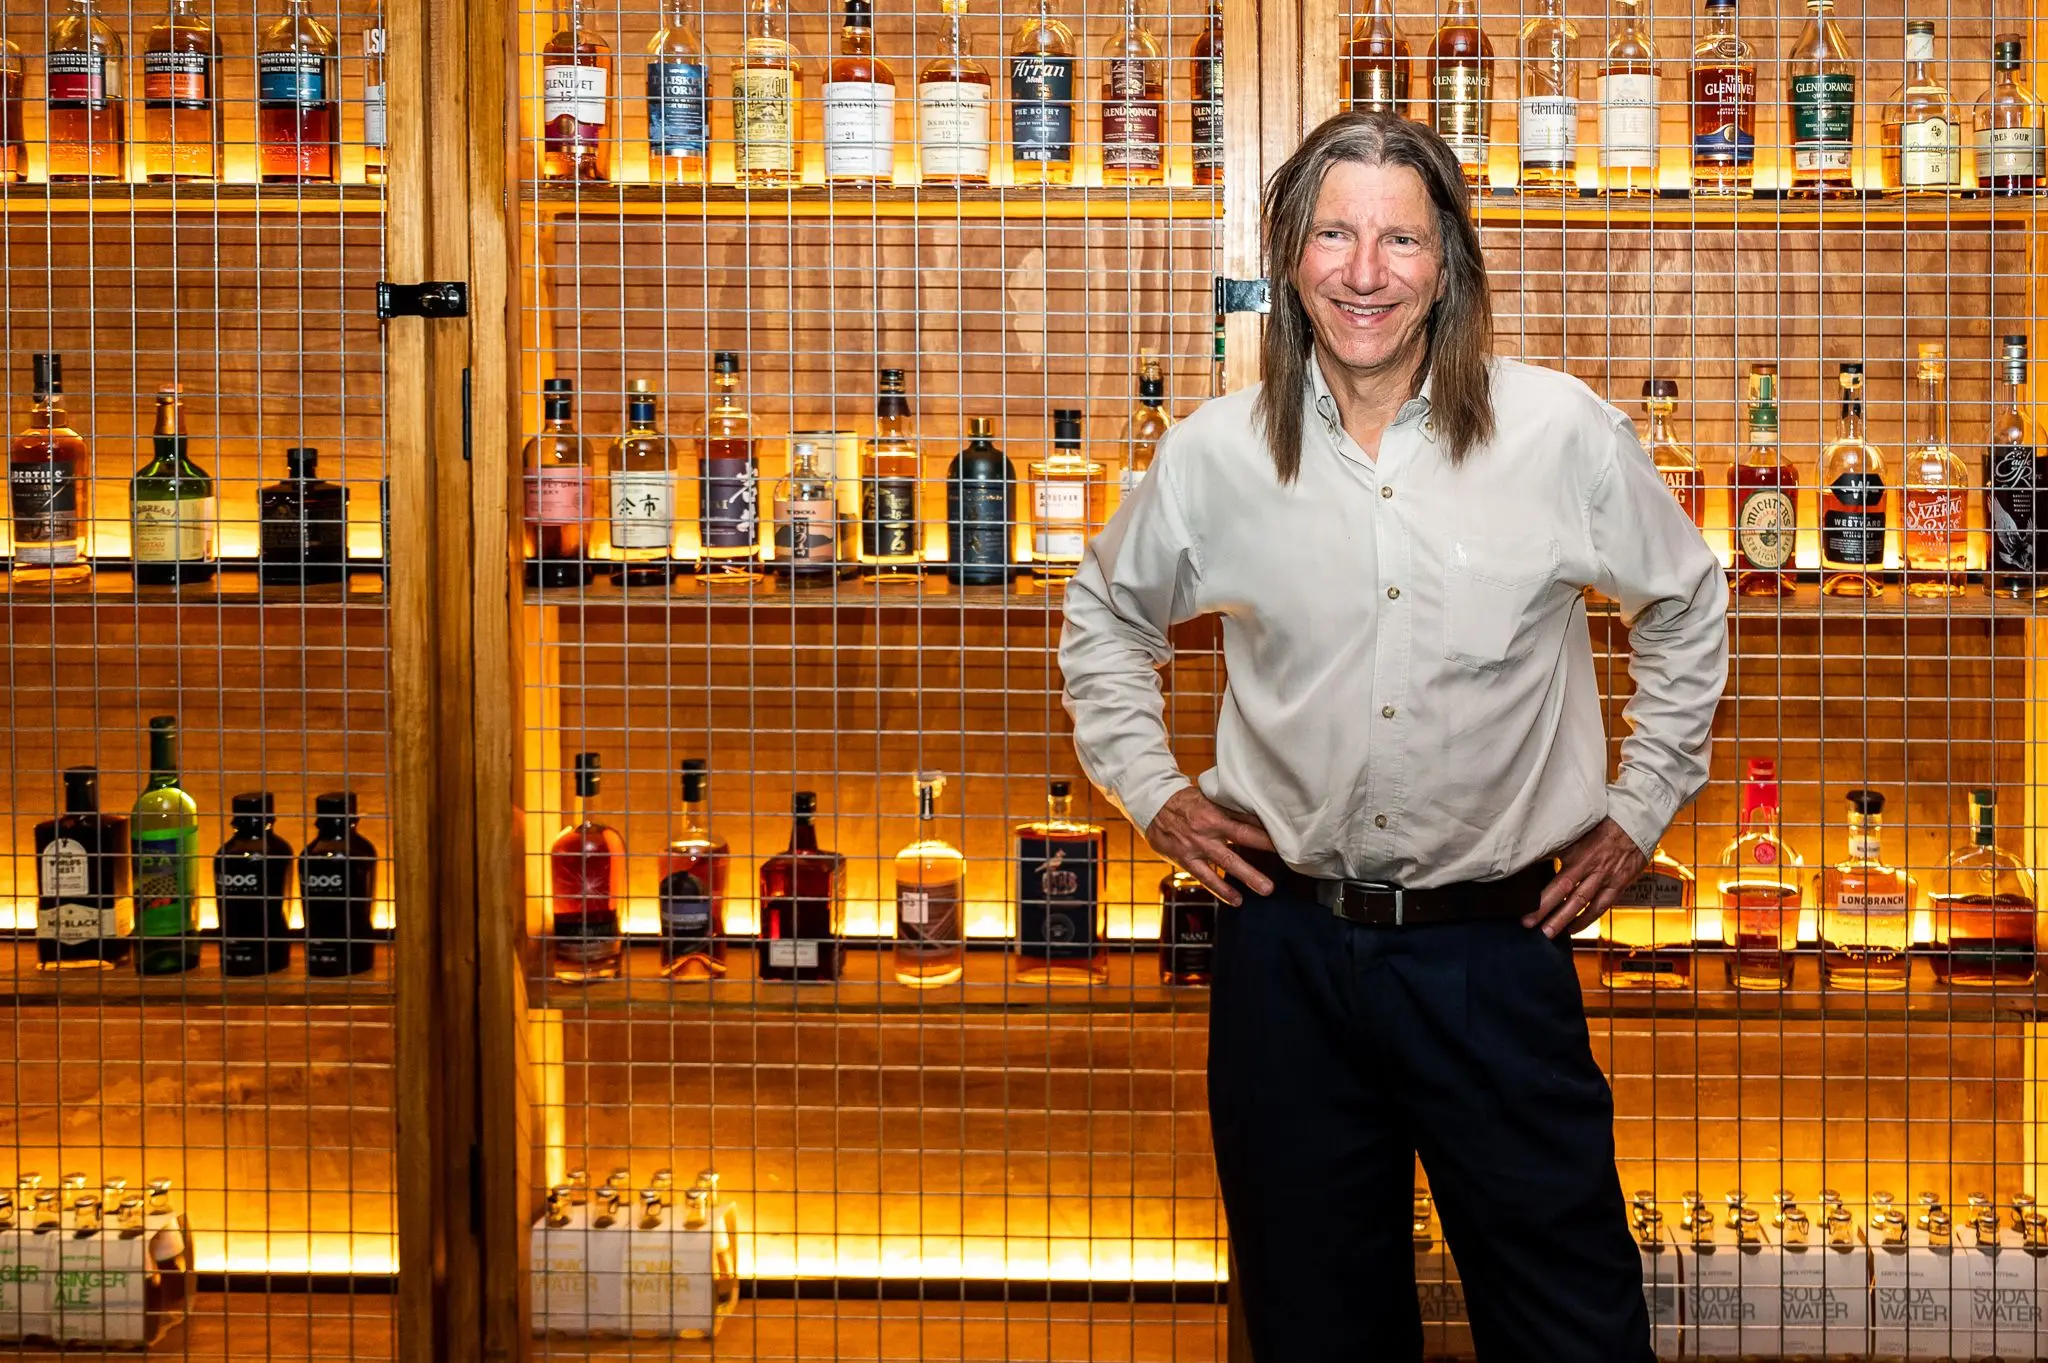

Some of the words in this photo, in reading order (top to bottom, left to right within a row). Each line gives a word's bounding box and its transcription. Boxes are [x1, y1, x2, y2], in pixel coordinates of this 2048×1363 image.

[558, 71, 574, 79] THE
[1012, 59, 1065, 78] Arran
[1025, 75, 1043, 84] Mal
[560, 90, 572, 102] 15
[1931, 165, 1940, 173] 15
[1906, 498, 1963, 529] SAZERAC
[1746, 537, 1779, 561] STRAIGH
[219, 873, 258, 887] DOG
[306, 873, 342, 887] DOG
[1841, 895, 1904, 906] LONGBRANCH
[1181, 931, 1209, 942] NANT
[55, 1271, 128, 1288] GINGER
[533, 1274, 598, 1294] WATER
[625, 1276, 691, 1295] WATER
[55, 1287, 91, 1305] ALE
[1416, 1283, 1458, 1299] ODA
[1688, 1286, 1740, 1303] SODA
[1782, 1287, 1836, 1302] SODA
[1879, 1288, 1935, 1304] SODA
[1973, 1288, 2030, 1305] SODA
[1689, 1302, 1756, 1321] WATER
[1782, 1302, 1849, 1320] WATER
[1879, 1303, 1949, 1322] WATER
[1973, 1304, 2043, 1323] WATER
